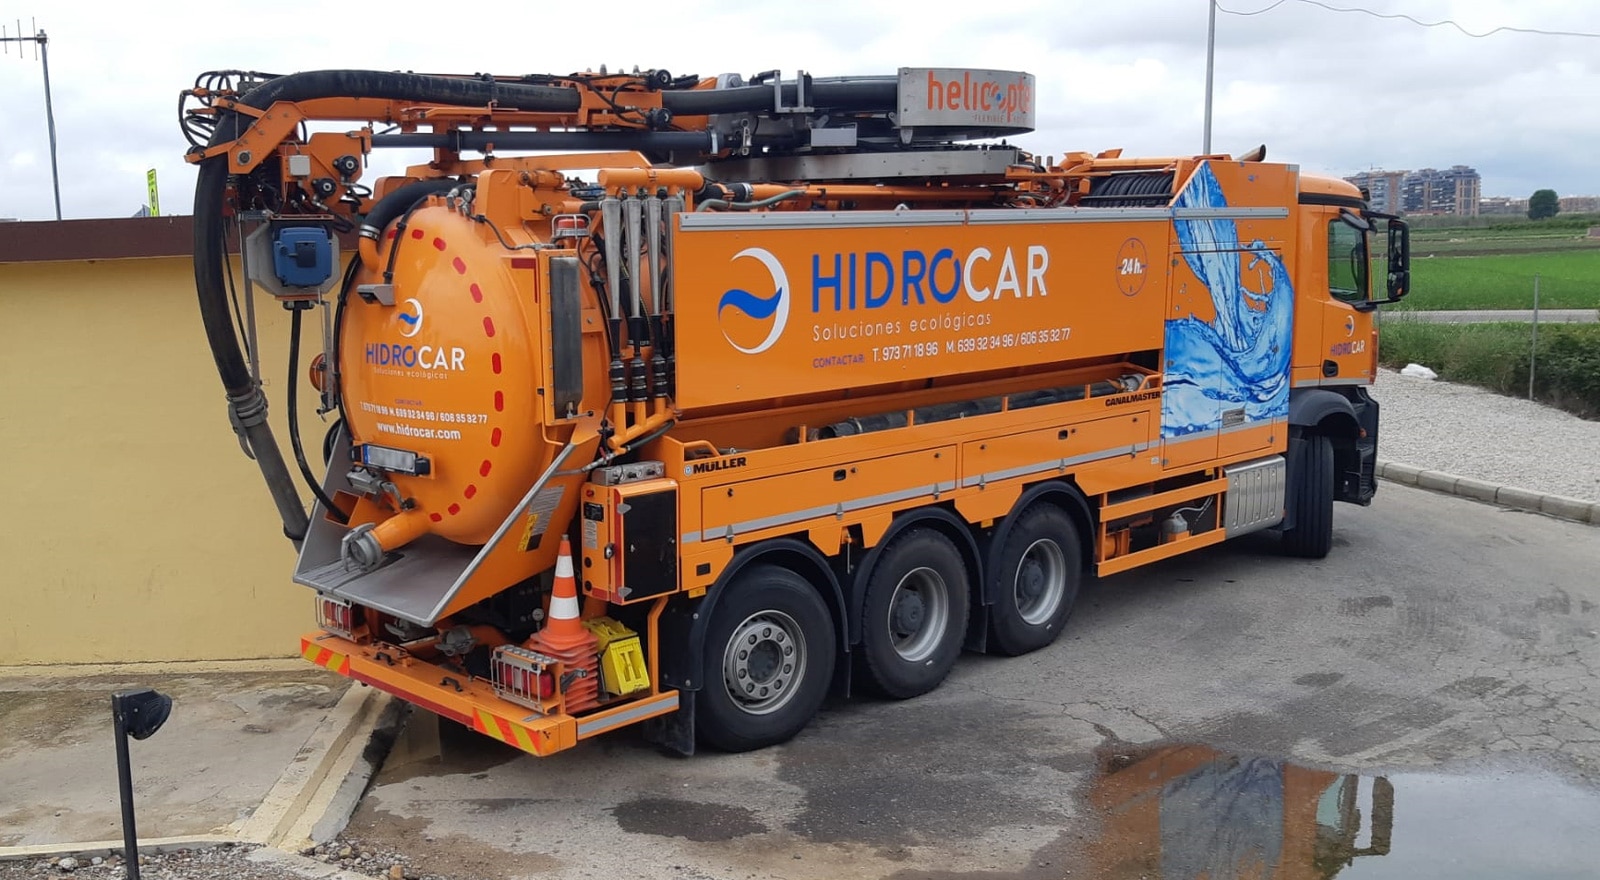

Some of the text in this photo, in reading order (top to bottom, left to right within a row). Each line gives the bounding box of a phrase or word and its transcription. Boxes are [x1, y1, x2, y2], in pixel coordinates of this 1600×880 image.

[812, 245, 1049, 313] HIDROCAR
[812, 311, 992, 342] Soluciones ecológicas
[872, 347, 881, 362] T.
[882, 345, 900, 361] 973
[902, 344, 912, 359] 71
[914, 342, 924, 357] 18
[926, 341, 938, 356] 96
[957, 338, 975, 353] 639
[977, 337, 988, 351] 32
[990, 335, 1001, 349] 34
[1002, 333, 1014, 348] 96
[1014, 333, 1020, 347] /
[1021, 331, 1037, 345] 606
[1038, 329, 1049, 343] 35
[1050, 328, 1060, 342] 32
[1061, 327, 1072, 341] 77
[1331, 339, 1365, 357] HIDROCAR
[366, 343, 465, 371] HIDROCAR
[1105, 391, 1160, 407] CANALMASTER
[377, 421, 461, 440] www.hidrocar.com
[693, 457, 746, 474] MÜLLER
